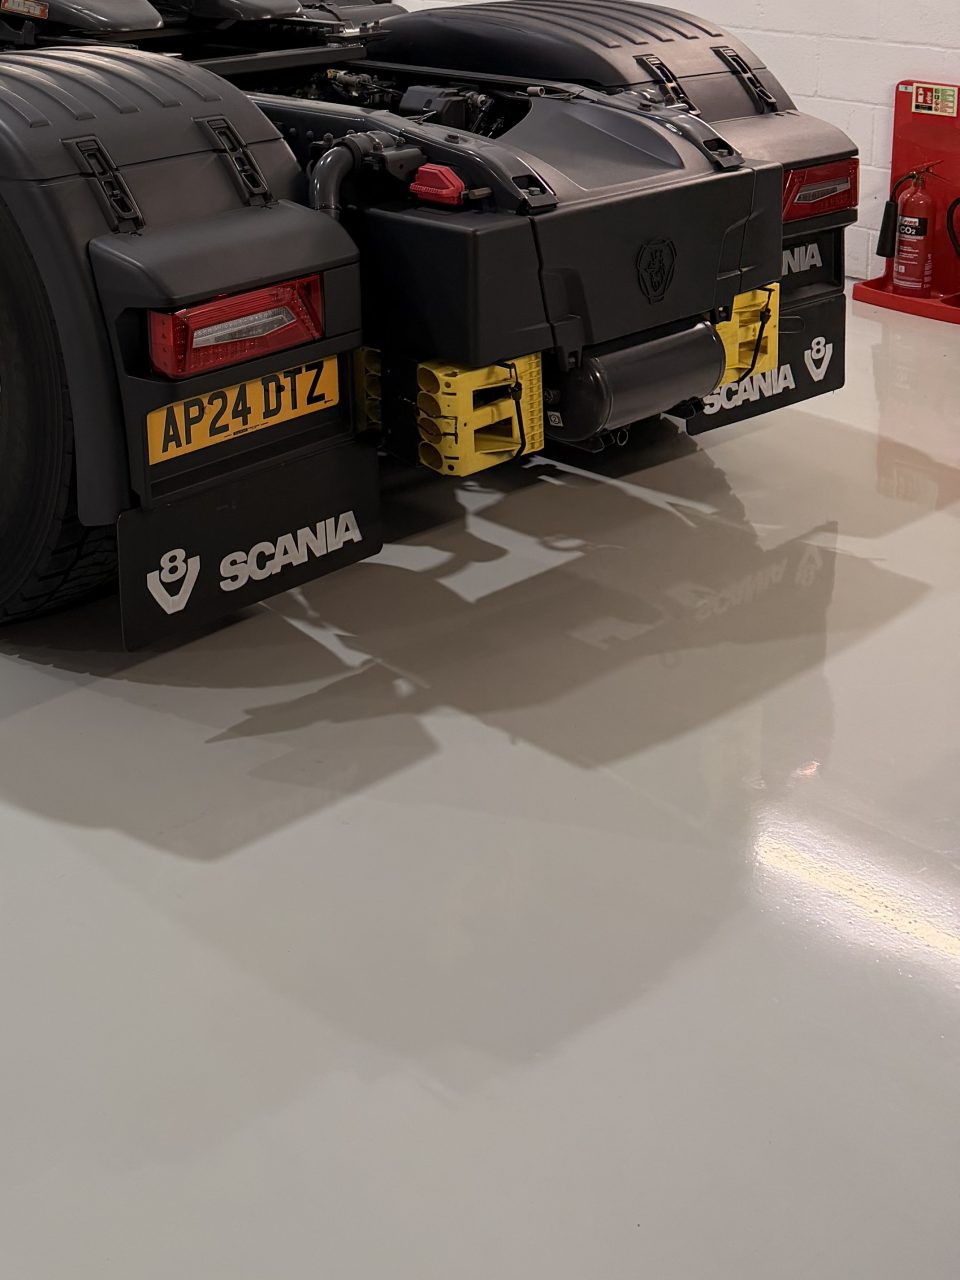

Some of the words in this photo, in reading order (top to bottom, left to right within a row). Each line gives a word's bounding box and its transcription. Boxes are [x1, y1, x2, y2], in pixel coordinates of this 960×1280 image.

[782, 242, 822, 277] NIA
[161, 384, 251, 453] AP24
[261, 360, 326, 420] DTZ
[702, 363, 796, 415] SCANIA
[219, 510, 362, 592] SCANIA
